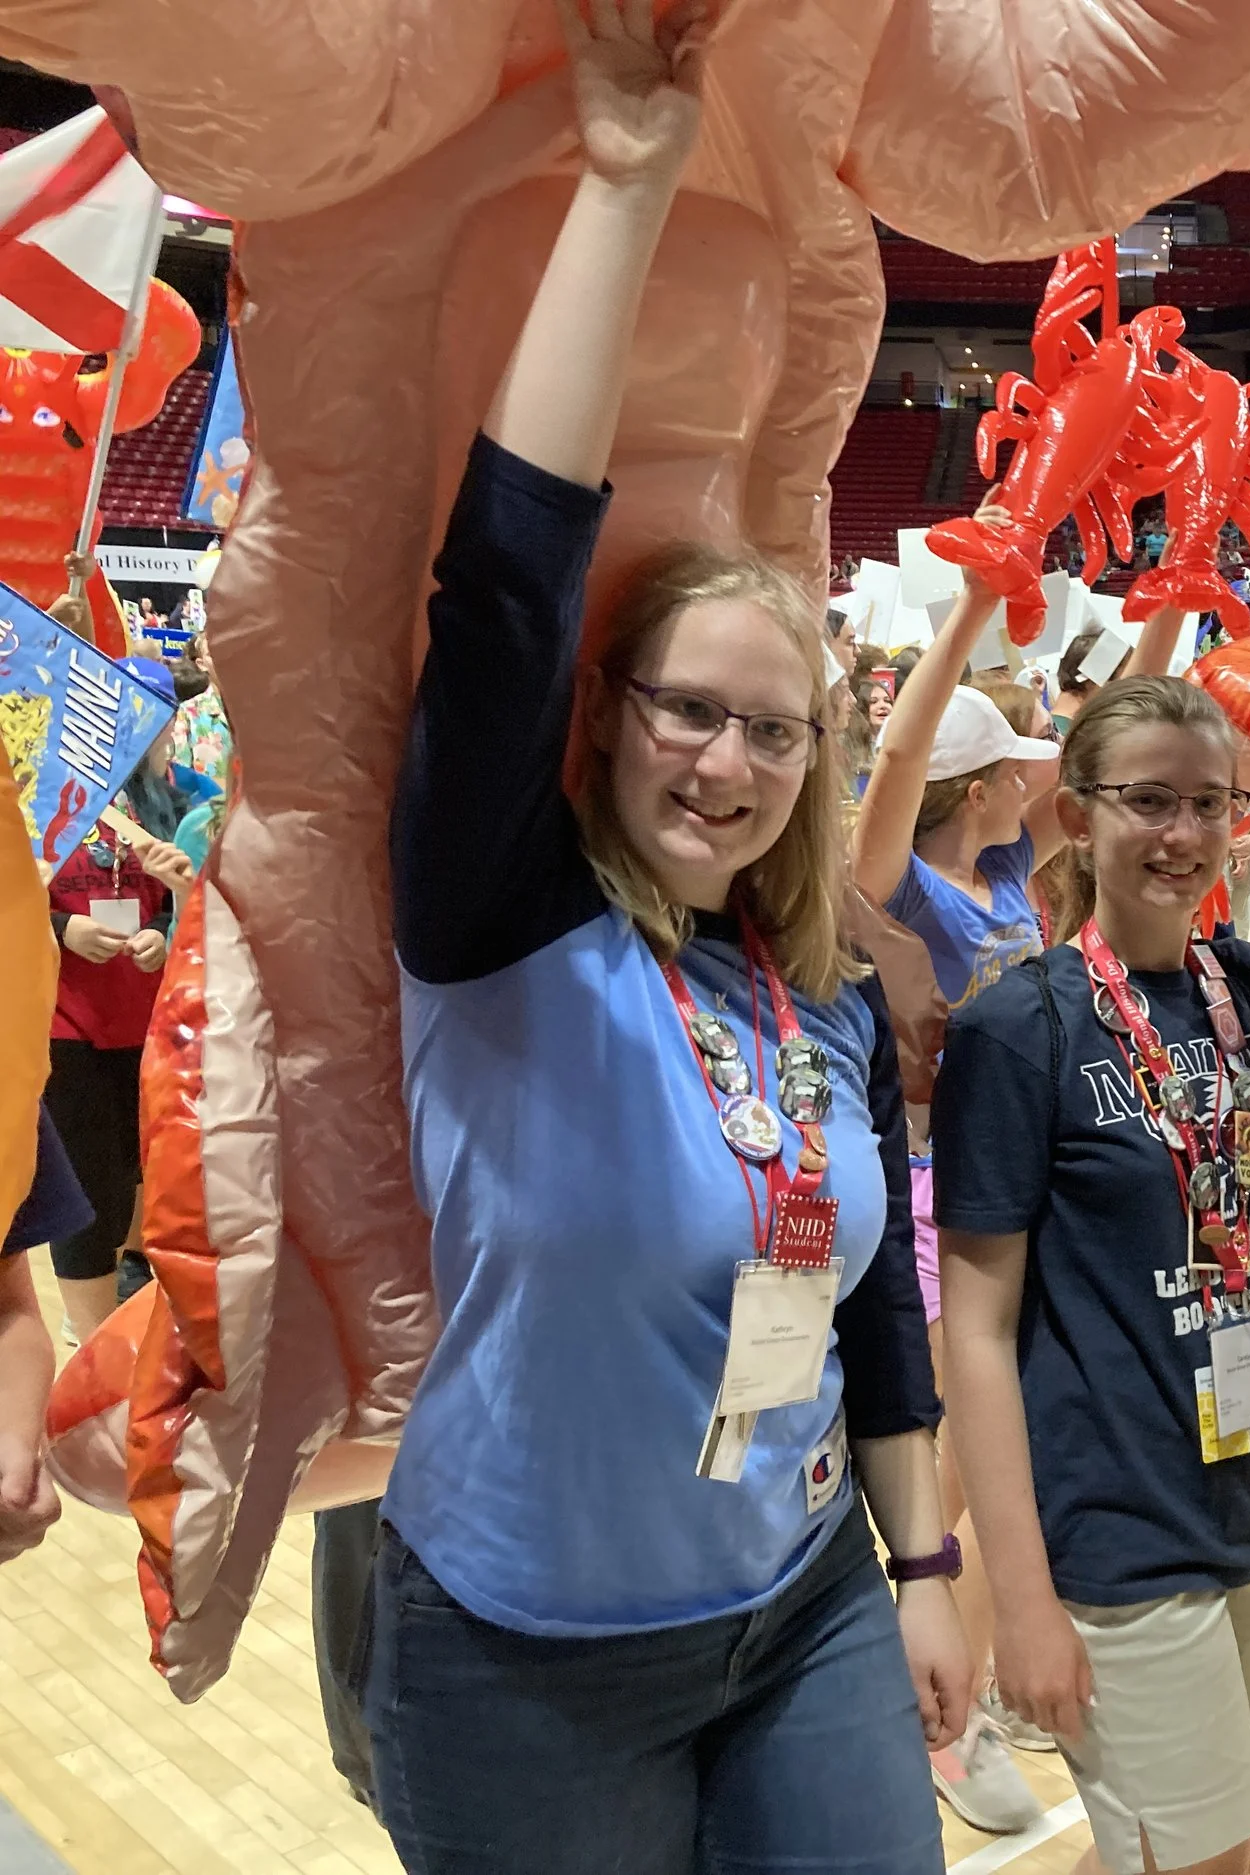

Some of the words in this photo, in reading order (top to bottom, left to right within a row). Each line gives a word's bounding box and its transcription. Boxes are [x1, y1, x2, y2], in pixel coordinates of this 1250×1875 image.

[118, 554, 180, 574] History
[58, 648, 122, 791] MAINE
[786, 1216, 827, 1238] NHD
[783, 1235, 823, 1249] Student
